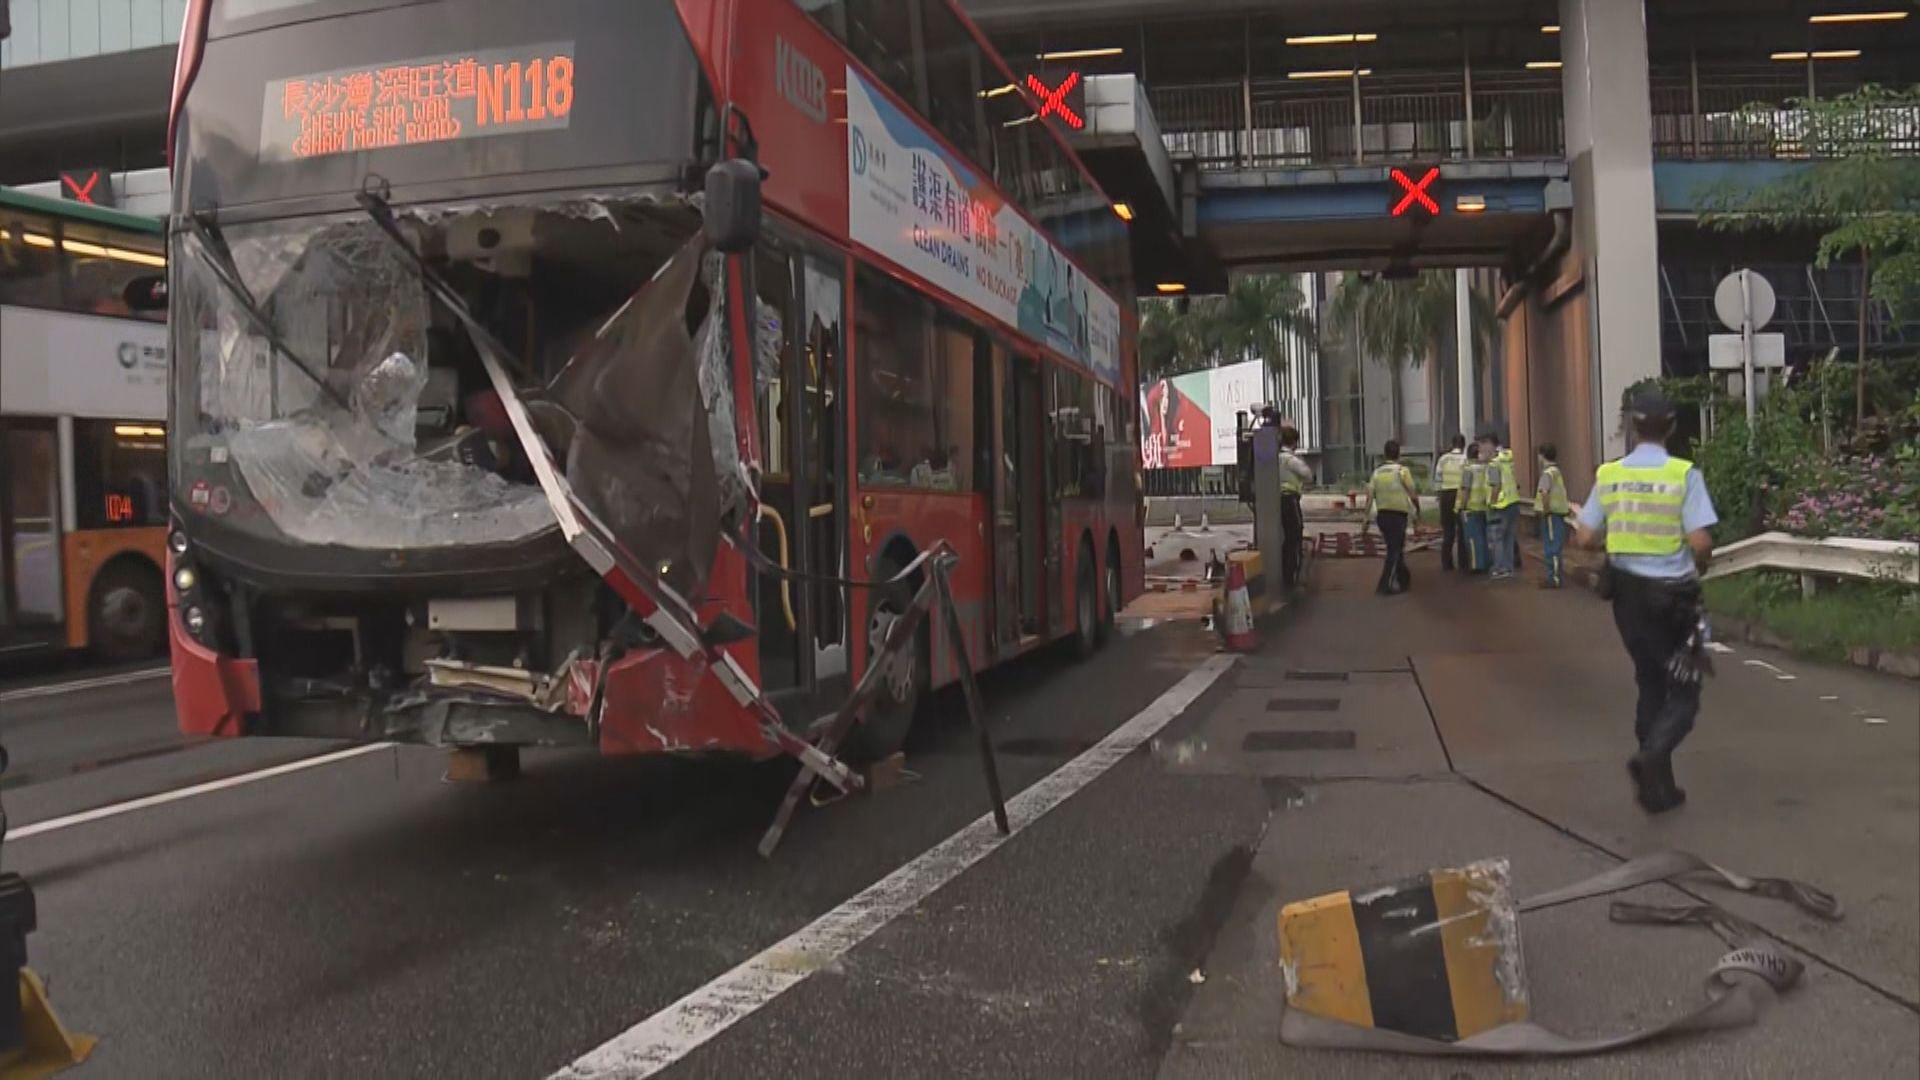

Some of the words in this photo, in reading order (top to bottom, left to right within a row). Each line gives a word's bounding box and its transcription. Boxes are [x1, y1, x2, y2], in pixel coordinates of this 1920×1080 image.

[477, 55, 575, 128] N118
[413, 97, 450, 123] WAN
[940, 241, 969, 277] DRAINS
